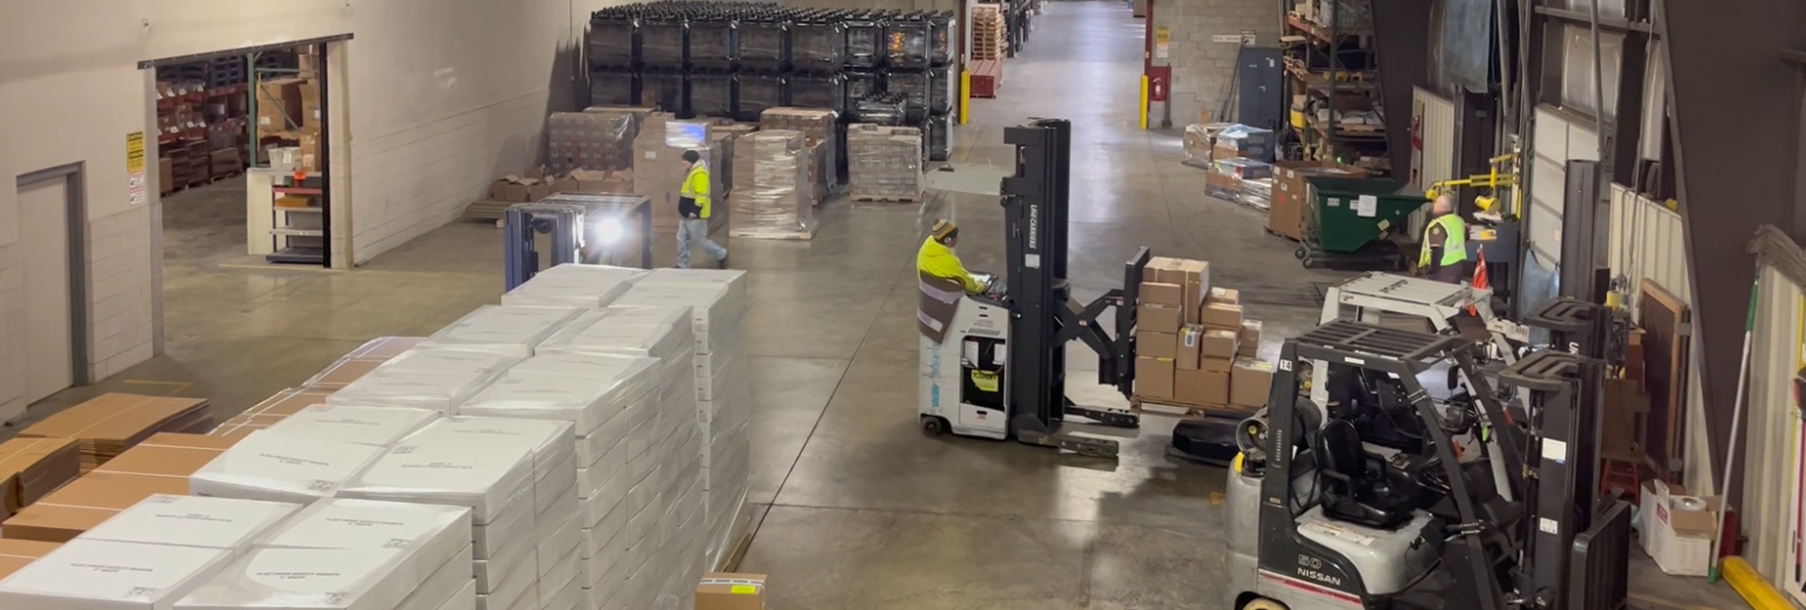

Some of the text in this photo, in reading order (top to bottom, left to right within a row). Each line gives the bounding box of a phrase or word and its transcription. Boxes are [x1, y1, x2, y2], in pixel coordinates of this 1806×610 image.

[1282, 360, 1291, 369] 14
[1298, 554, 1322, 569] 50
[1297, 567, 1341, 586] NISSAN
